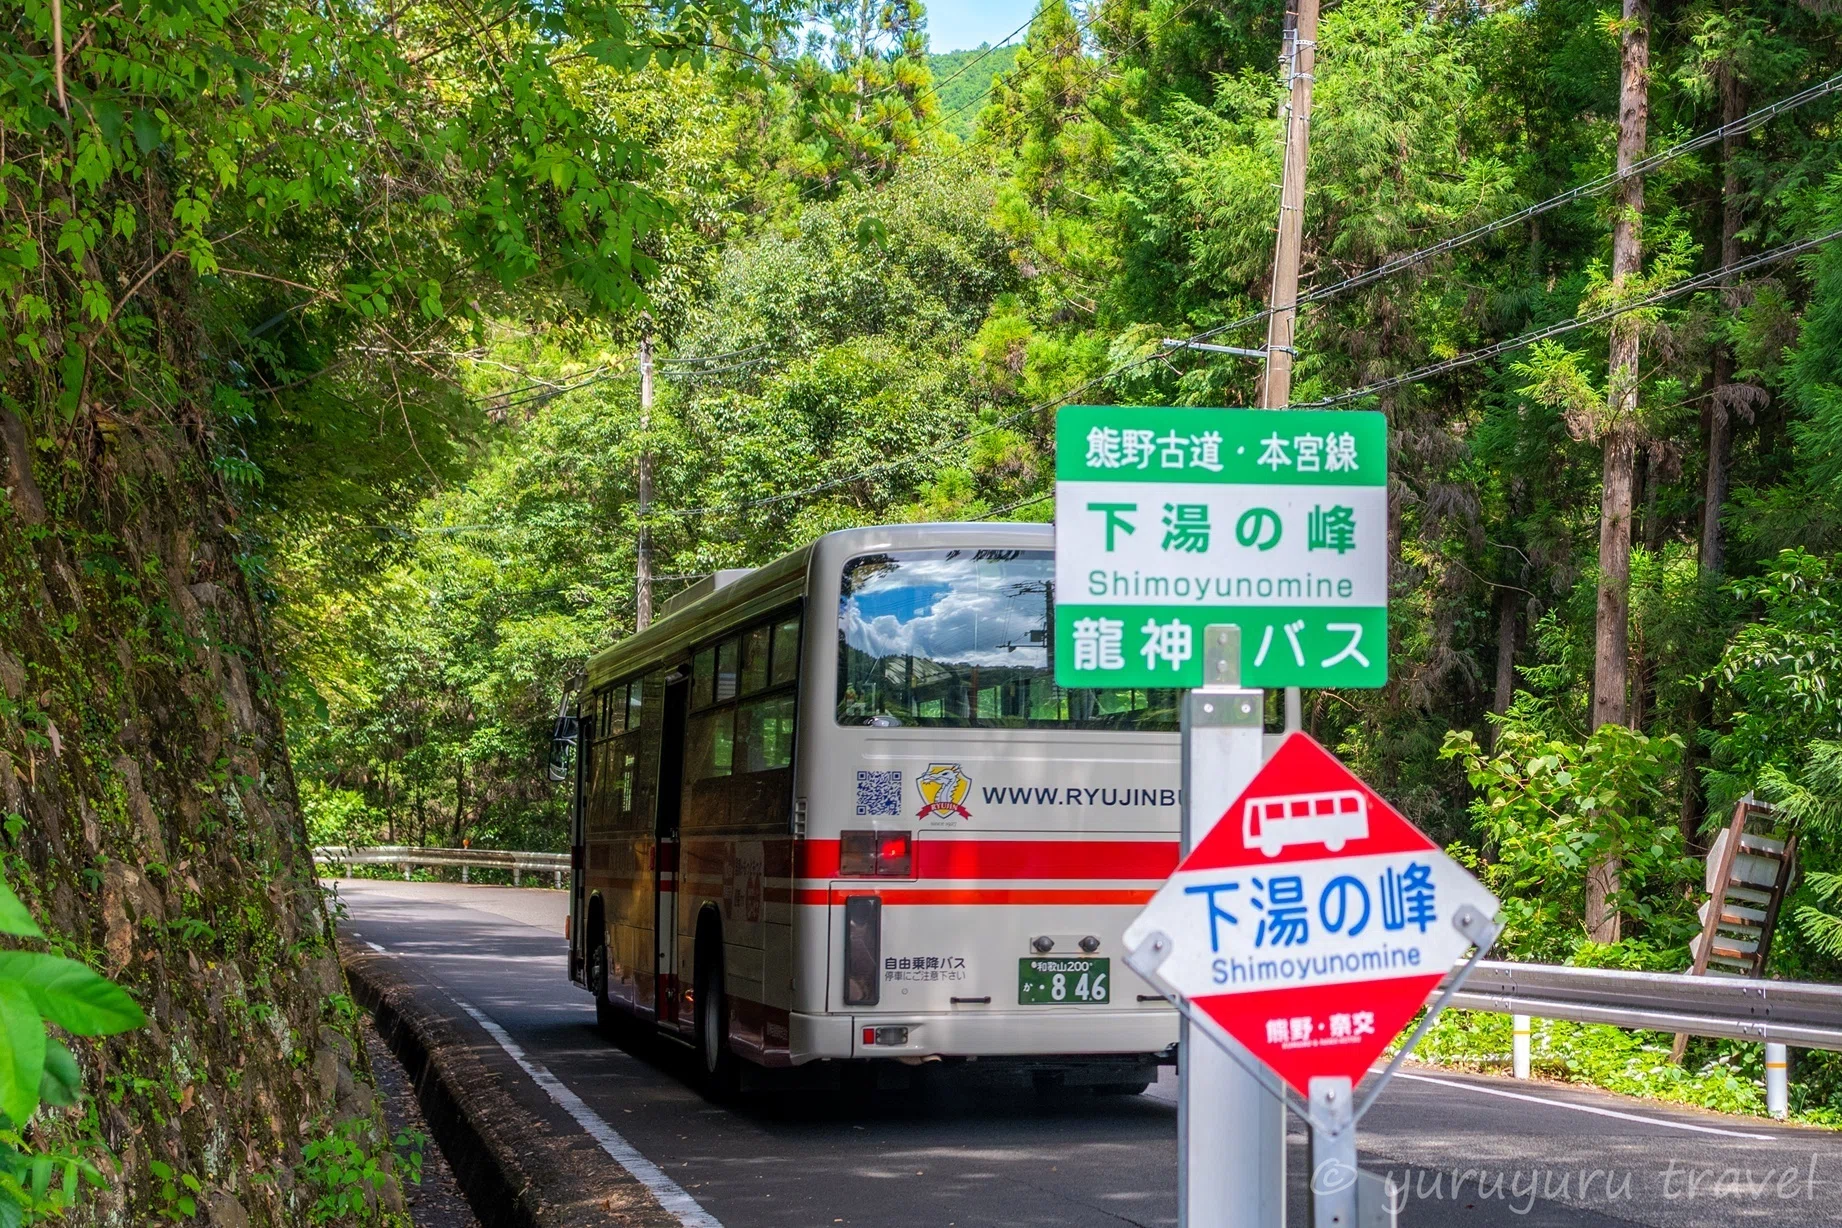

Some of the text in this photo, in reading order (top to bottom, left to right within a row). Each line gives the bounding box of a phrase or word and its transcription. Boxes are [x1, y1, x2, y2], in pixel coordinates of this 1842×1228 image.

[1085, 426, 1359, 472] 熊野古道・本宮線
[1086, 502, 1357, 555] 下湯の峰
[1088, 570, 1353, 601] Shimoyunomine
[930, 803, 958, 811] RYUJIN
[982, 786, 1183, 806] WWW.RYUJINB
[1184, 862, 1437, 952] 下湯の峰
[885, 957, 966, 970] 自由乗降バス
[885, 971, 966, 982] 停車にご注意下さい
[1212, 943, 1421, 984] Shimoyunomine
